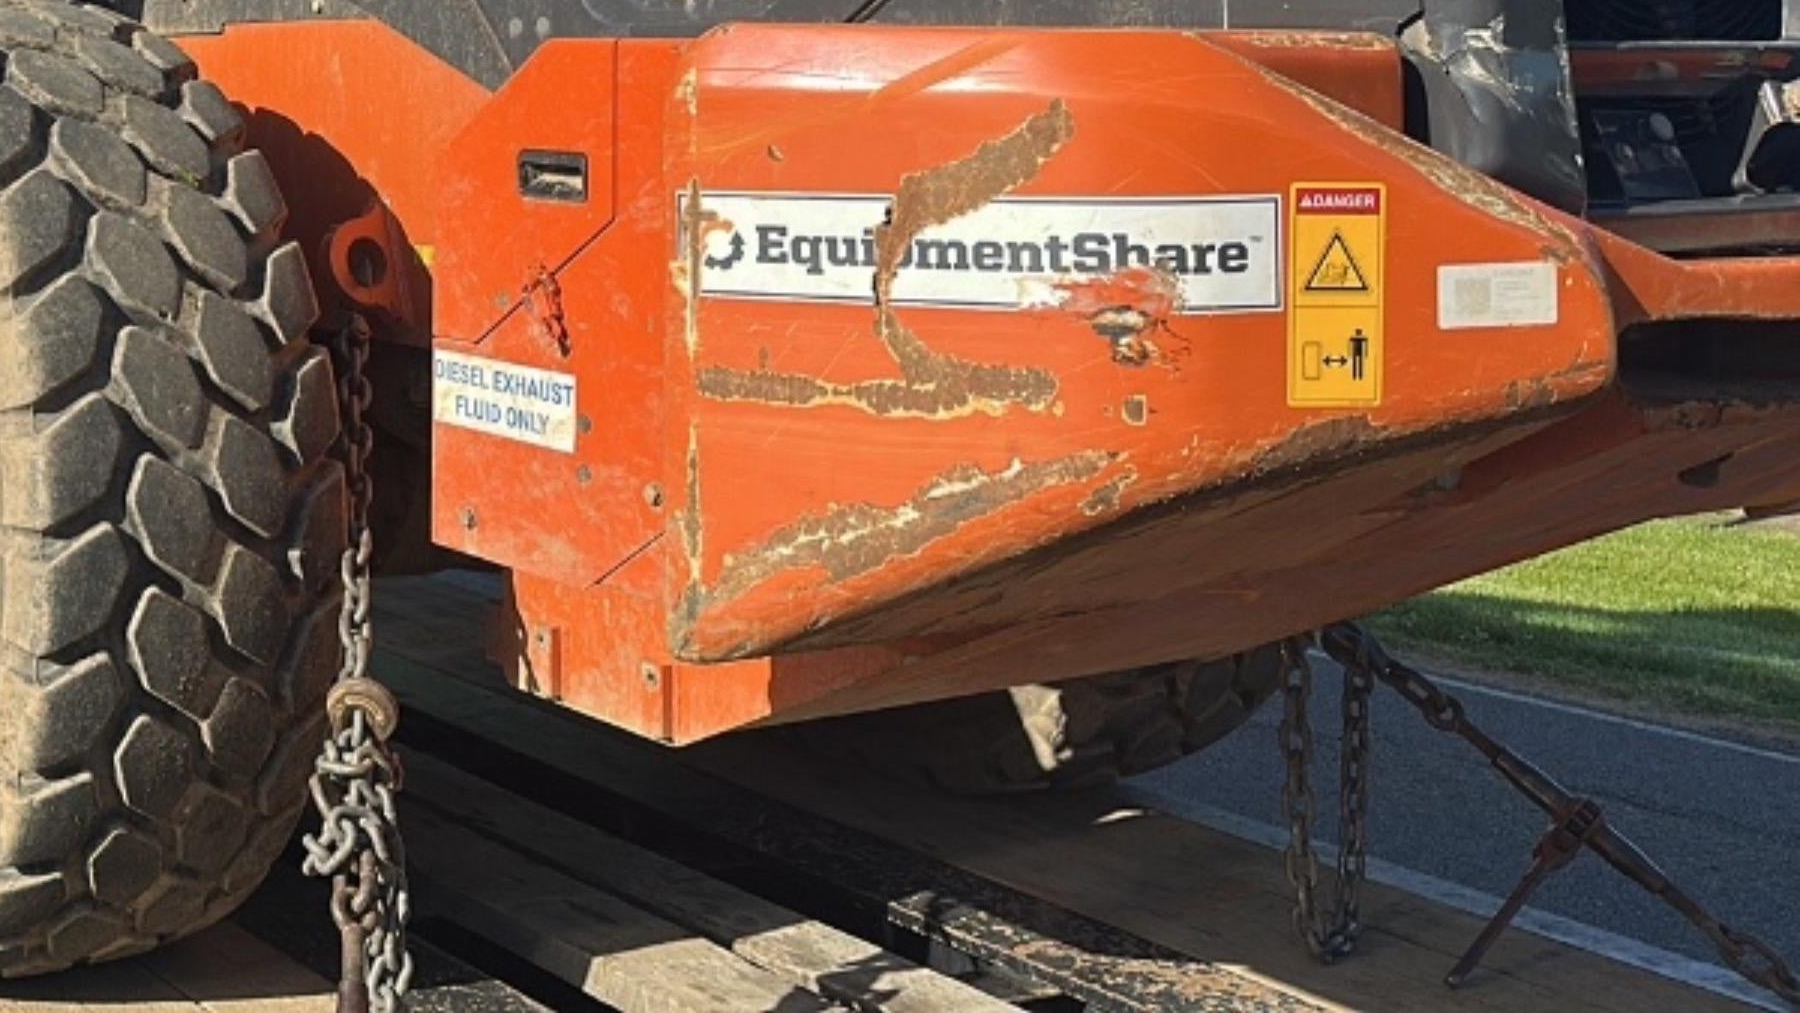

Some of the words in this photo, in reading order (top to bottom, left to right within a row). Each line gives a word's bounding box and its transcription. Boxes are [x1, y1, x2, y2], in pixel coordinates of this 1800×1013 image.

[1311, 193, 1376, 209] DANGER
[433, 358, 490, 390] DIESEL
[492, 370, 574, 407] EXHAUST
[455, 394, 502, 423] FLUID
[506, 406, 550, 435] ONLY
